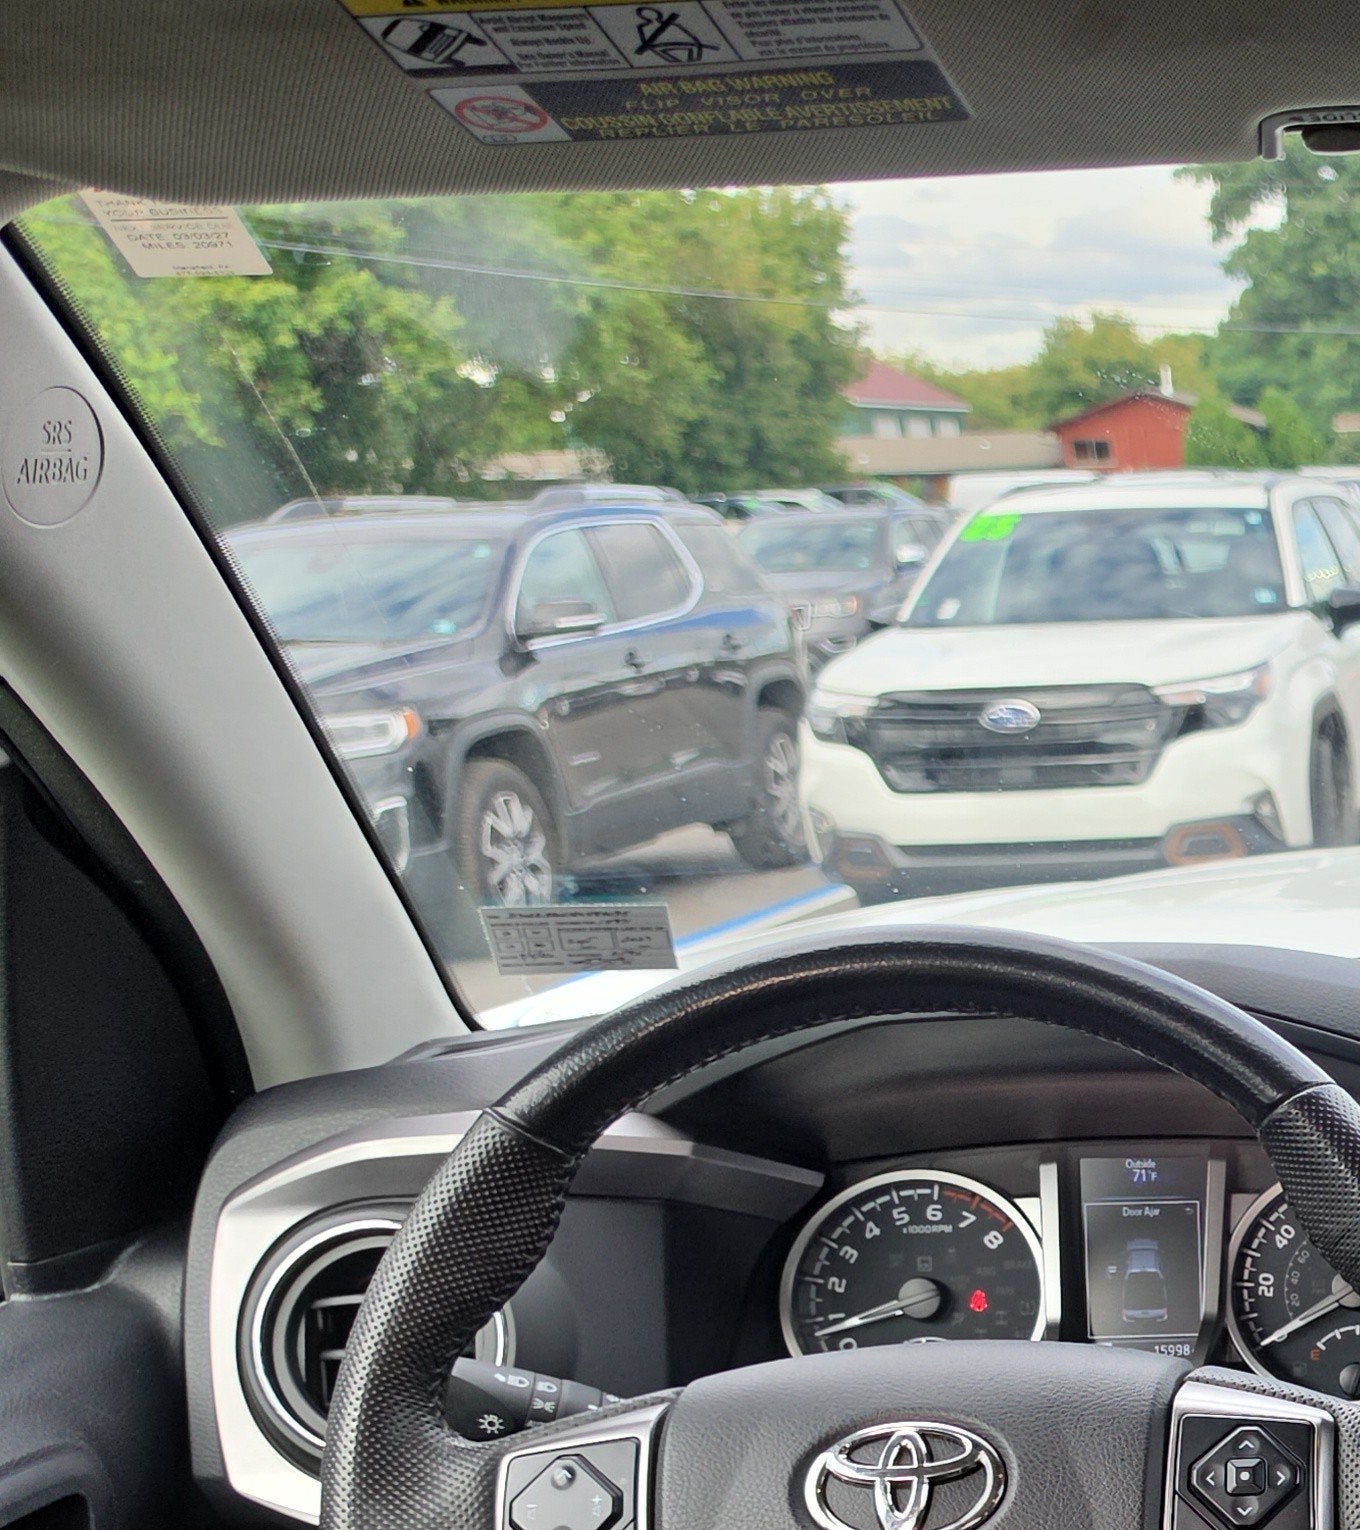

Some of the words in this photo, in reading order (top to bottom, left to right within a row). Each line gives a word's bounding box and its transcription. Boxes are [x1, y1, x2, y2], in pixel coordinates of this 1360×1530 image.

[727, 71, 835, 91] WARNING
[126, 233, 166, 242] DATE
[141, 242, 186, 250] MILES
[42, 419, 73, 446] SRS
[16, 456, 89, 485] AIRBAG
[1125, 1158, 1156, 1170] Outside
[892, 1207, 911, 1226] 5
[926, 1204, 943, 1221] 6
[958, 1211, 977, 1228] 7
[1122, 1207, 1142, 1217] Door
[864, 1222, 881, 1239] 4
[1274, 1225, 1296, 1249] 40
[983, 1230, 1004, 1250] 8
[839, 1245, 859, 1264] 3
[1297, 1250, 1310, 1264] 60
[828, 1276, 847, 1293] 2
[1258, 1272, 1275, 1297] 20
[1291, 1270, 1301, 1285] 40
[1291, 1292, 1301, 1307] 20
[828, 1312, 846, 1321] 1
[1154, 1343, 1191, 1357] 15998
[1310, 1348, 1321, 1361] E
